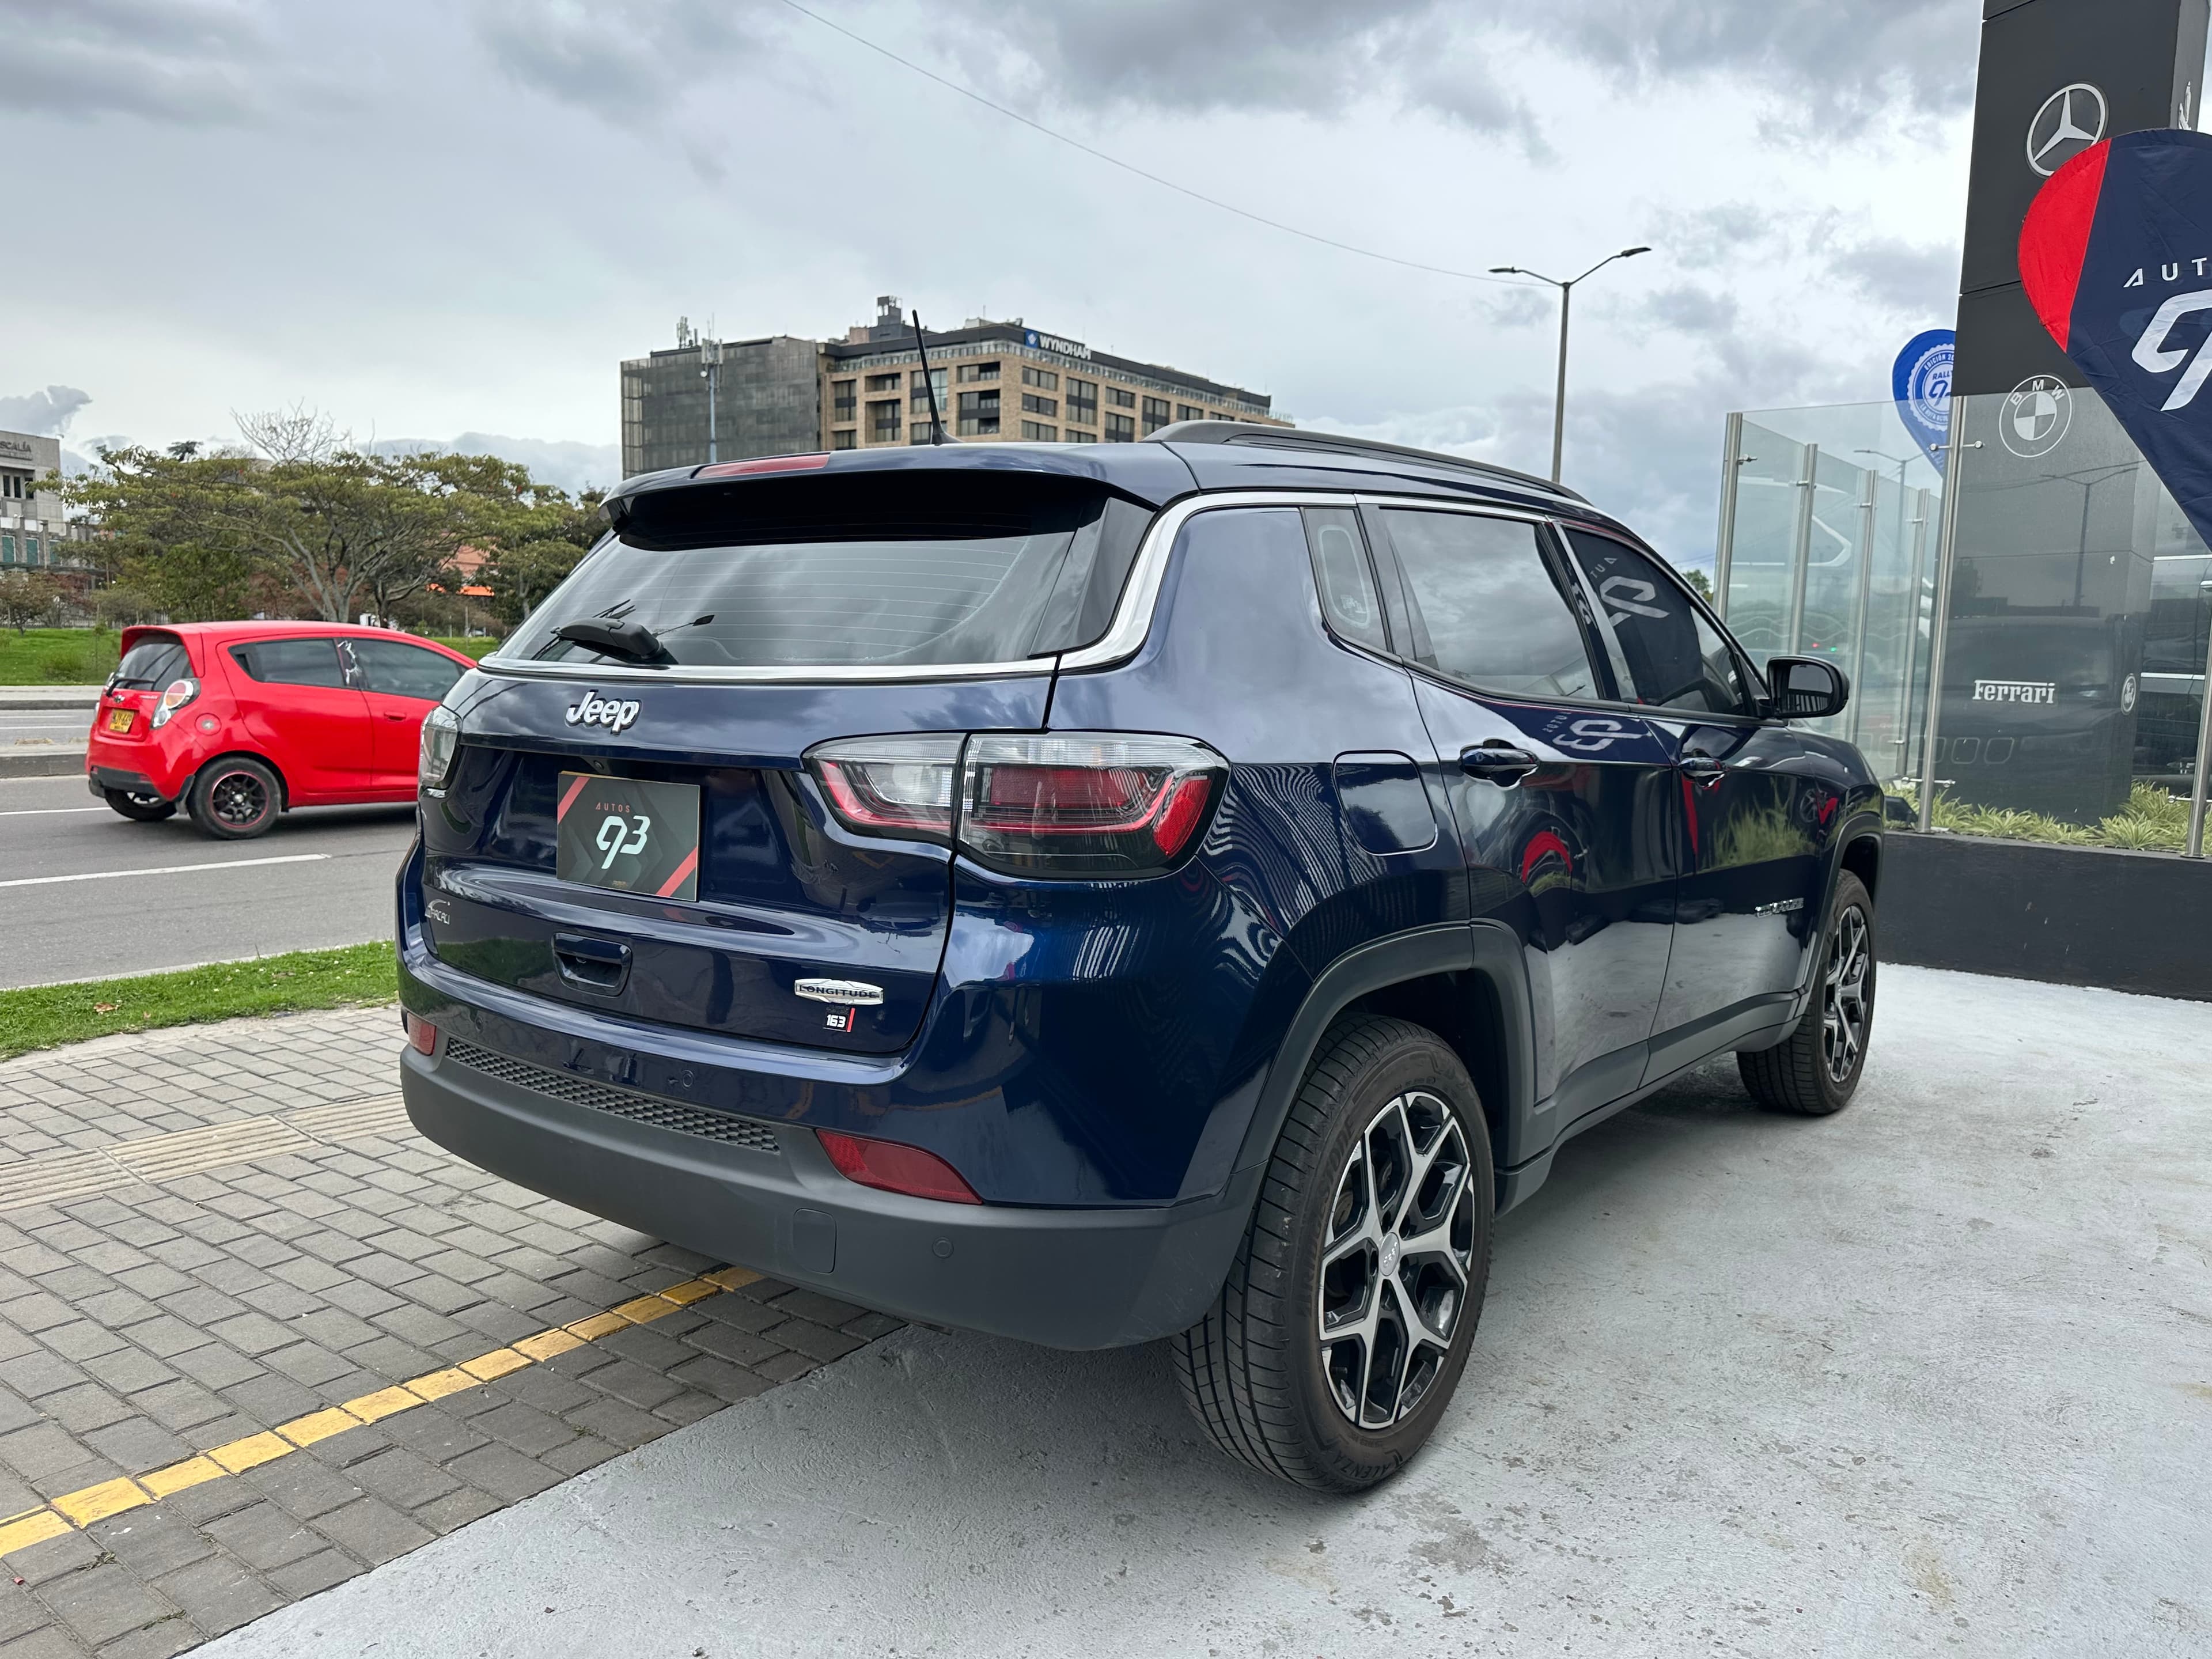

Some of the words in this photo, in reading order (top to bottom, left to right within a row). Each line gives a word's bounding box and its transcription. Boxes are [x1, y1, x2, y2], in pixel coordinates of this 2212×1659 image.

[1039, 335, 1092, 360] WYNDHAM
[1932, 371, 1952, 380] RALL
[2009, 379, 2065, 406] BMW
[1972, 679, 2055, 704] Ferrari
[566, 690, 641, 736] Jeep
[595, 802, 631, 813] AUTOS
[596, 815, 650, 870] 93
[799, 984, 880, 999] LONGITUDE
